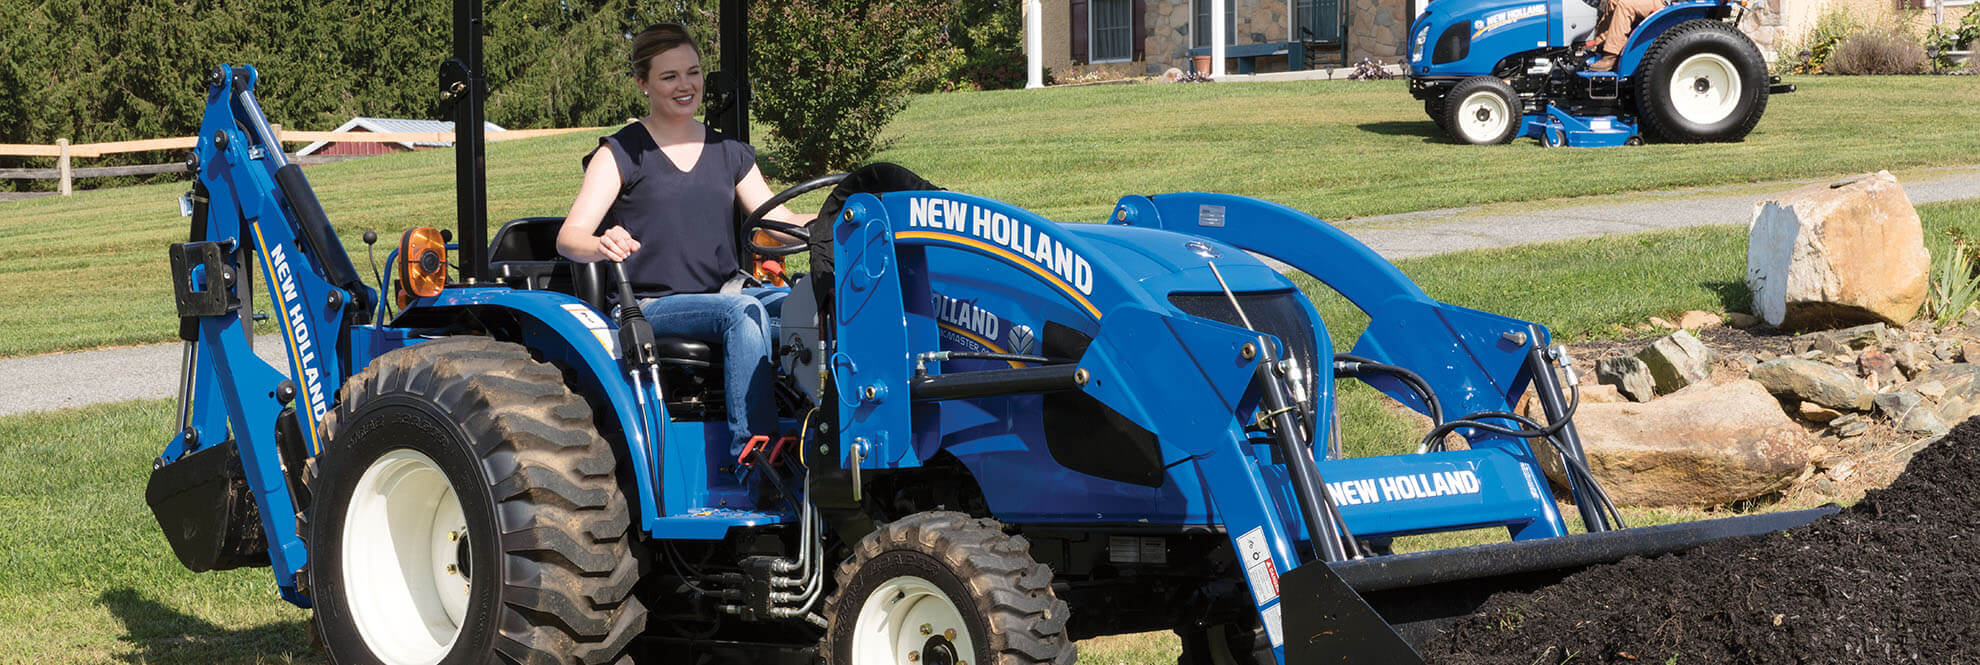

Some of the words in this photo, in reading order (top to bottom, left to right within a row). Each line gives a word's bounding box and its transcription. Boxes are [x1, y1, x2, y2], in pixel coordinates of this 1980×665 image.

[1486, 12, 1507, 26] NEW
[1507, 4, 1545, 20] HOLLAND
[909, 197, 967, 233] NEW
[972, 205, 1093, 296] HOLLAND
[271, 243, 298, 302] NEW
[289, 303, 327, 422] HOLLAND
[933, 293, 999, 341] OLLAND
[1326, 479, 1380, 507] NEW
[1379, 470, 1480, 501] HOLLAND
